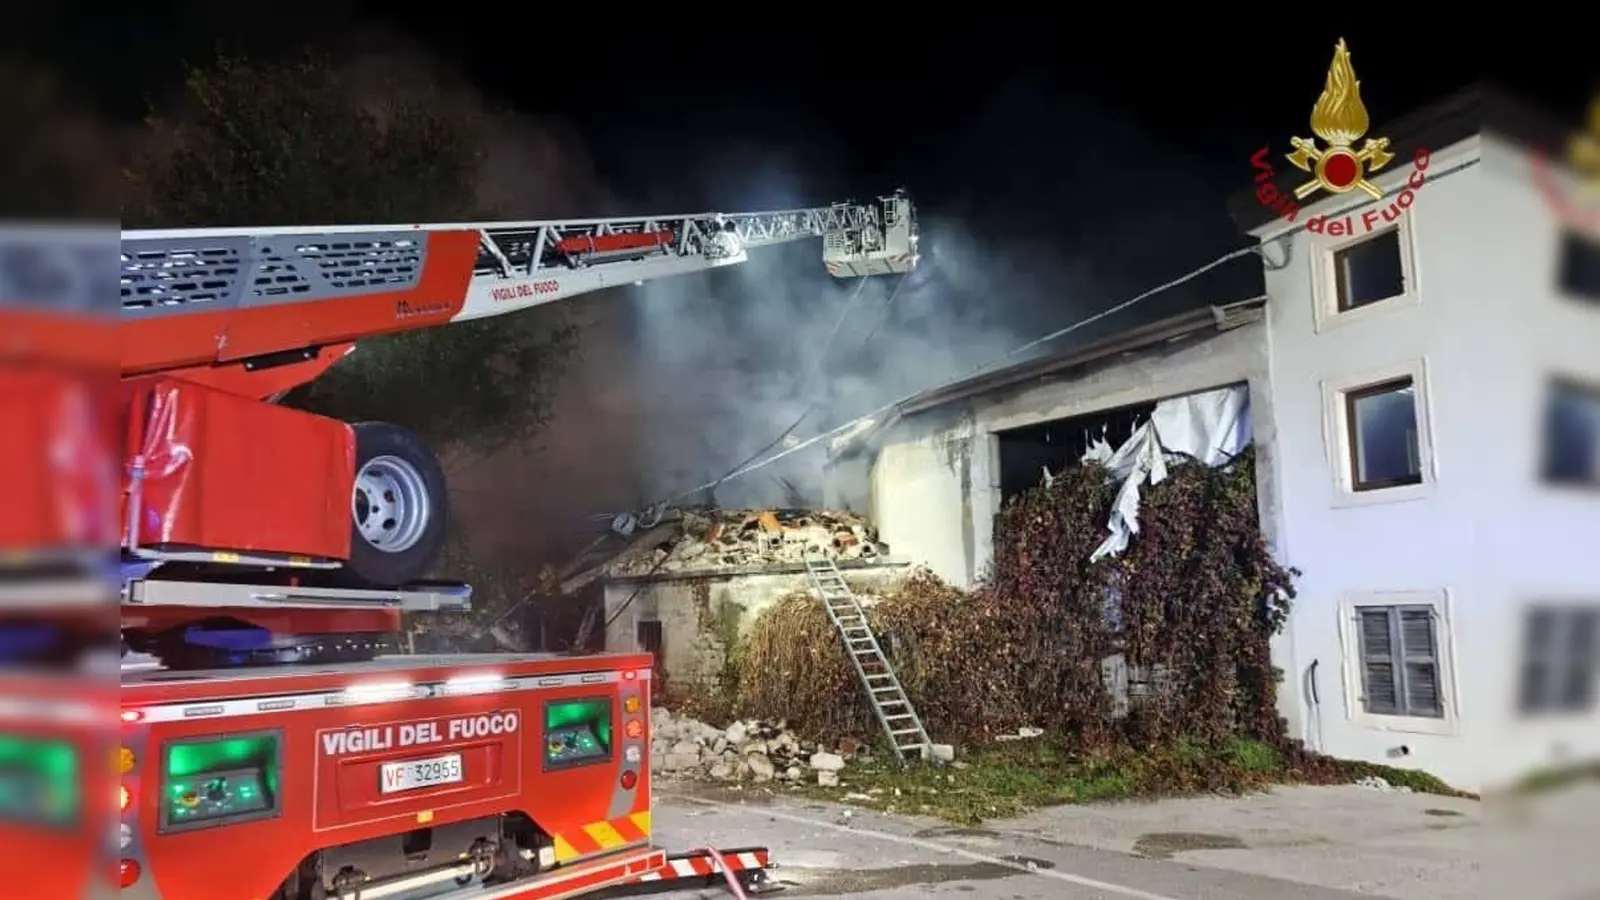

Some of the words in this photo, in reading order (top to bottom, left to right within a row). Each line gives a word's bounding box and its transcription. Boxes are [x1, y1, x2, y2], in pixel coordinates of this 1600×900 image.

[492, 287, 516, 301] VIGILI
[516, 284, 533, 297] DEL
[534, 279, 559, 294] FUOCO
[323, 727, 393, 755] VIGILI
[399, 722, 443, 746] DEL
[450, 713, 518, 739] FUOCO
[415, 760, 458, 782] 32955
